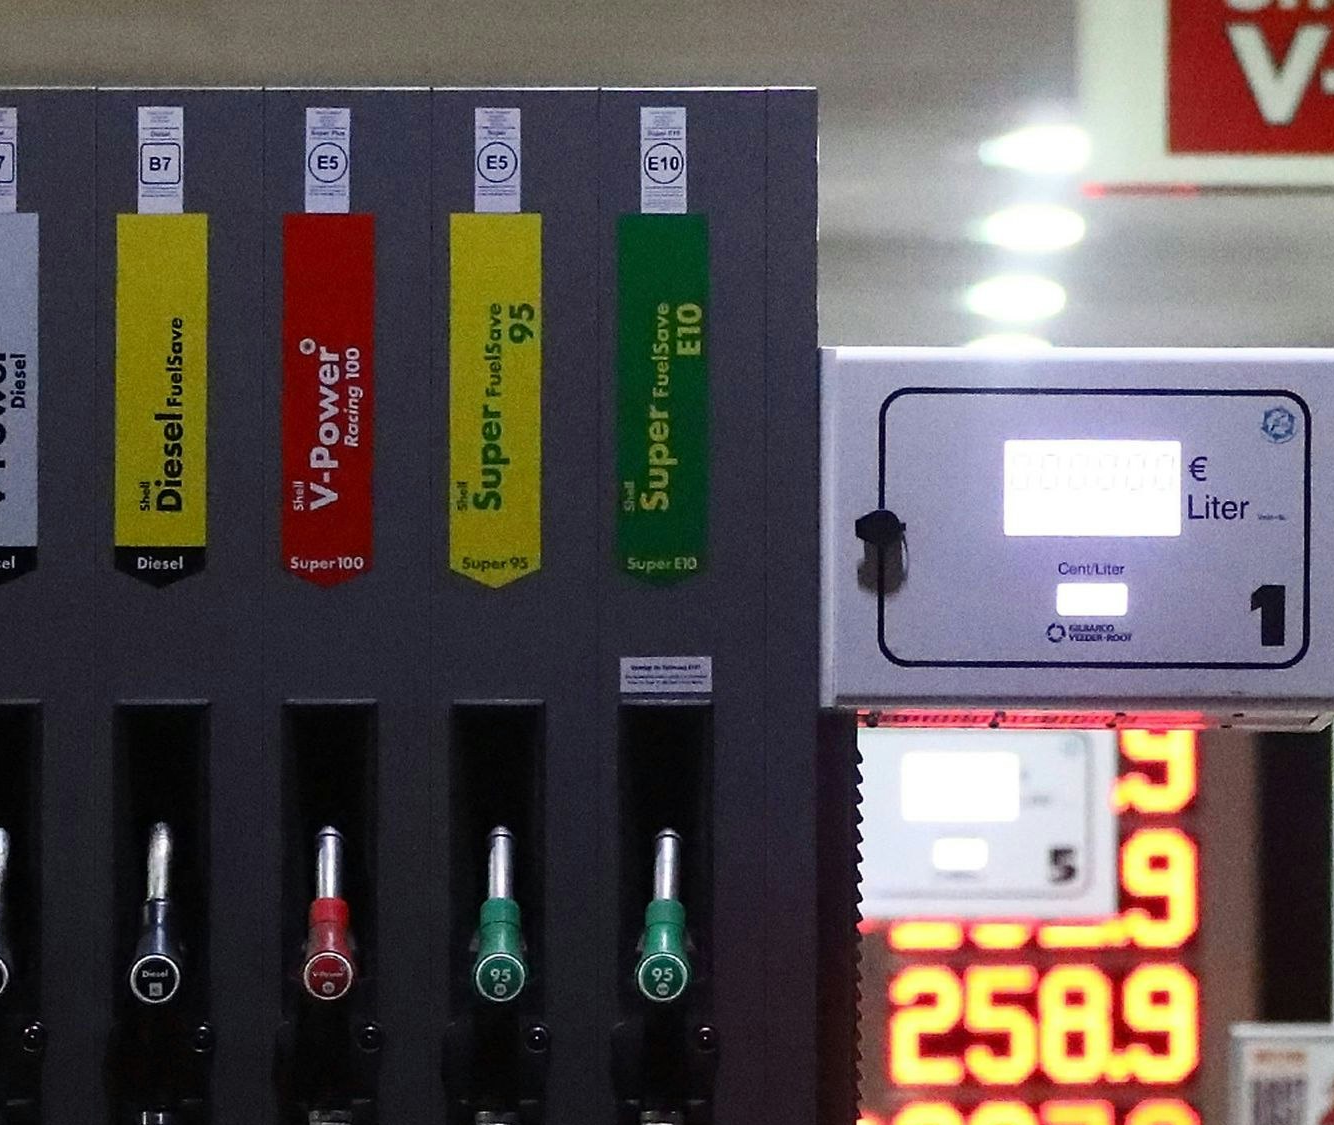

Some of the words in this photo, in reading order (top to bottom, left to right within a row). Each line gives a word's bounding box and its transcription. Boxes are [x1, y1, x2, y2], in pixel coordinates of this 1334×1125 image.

[149, 156, 172, 171] B7
[317, 155, 339, 170] E5
[486, 155, 508, 170] E5
[648, 156, 680, 171] E10
[508, 302, 535, 344] 95
[676, 302, 703, 356] E10
[165, 317, 183, 407] FuelSave
[345, 347, 360, 379] 100
[485, 302, 502, 398] FuelSave
[651, 302, 670, 398] FuelSave
[10, 354, 27, 409] Diesel
[309, 346, 340, 511] V-Power
[344, 386, 364, 447] Racing
[154, 413, 184, 512] Diesel
[473, 405, 510, 511] Super
[640, 404, 678, 512] Super
[1188, 456, 1208, 481] €
[139, 481, 151, 511] Shell
[293, 481, 304, 511] Shell
[1188, 494, 1250, 520] Liter
[136, 556, 184, 570] Diesel
[1058, 562, 1126, 576] Cent/Liter
[1250, 584, 1286, 647] 1
[1048, 847, 1079, 884] 5
[490, 968, 512, 982] 95
[651, 967, 674, 982] 95
[889, 964, 1199, 1085] 258.9
